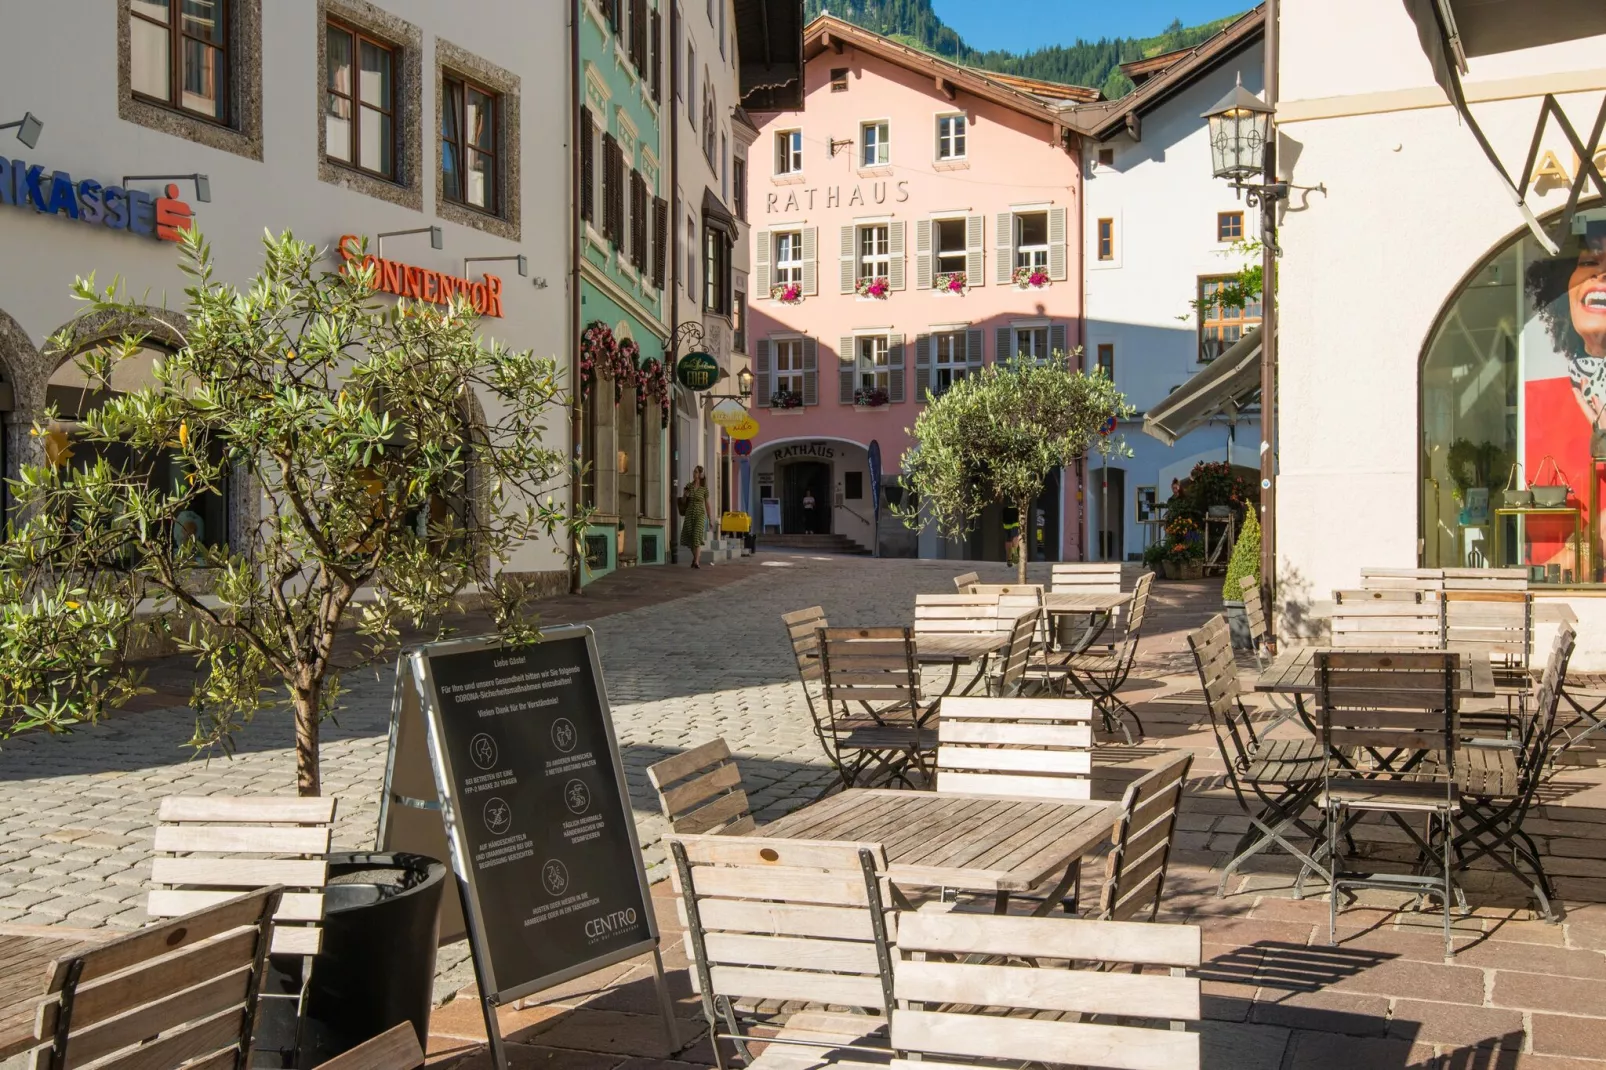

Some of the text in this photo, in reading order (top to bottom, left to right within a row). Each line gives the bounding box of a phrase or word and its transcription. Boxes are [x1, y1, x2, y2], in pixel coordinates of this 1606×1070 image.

[766, 181, 909, 214] RATHAUS
[338, 235, 504, 318] SONNENTOR
[774, 444, 834, 460] RATHAUS
[494, 656, 526, 668] Liebe Gäste!
[441, 666, 580, 694] Für Ihre und unsere Gesundheit bitten wir Sie folgende
[542, 677, 572, 688] einzuhalten!
[478, 697, 559, 717] Vielen Dank für Ihr Verständnis!
[585, 907, 637, 938] CENTRO
